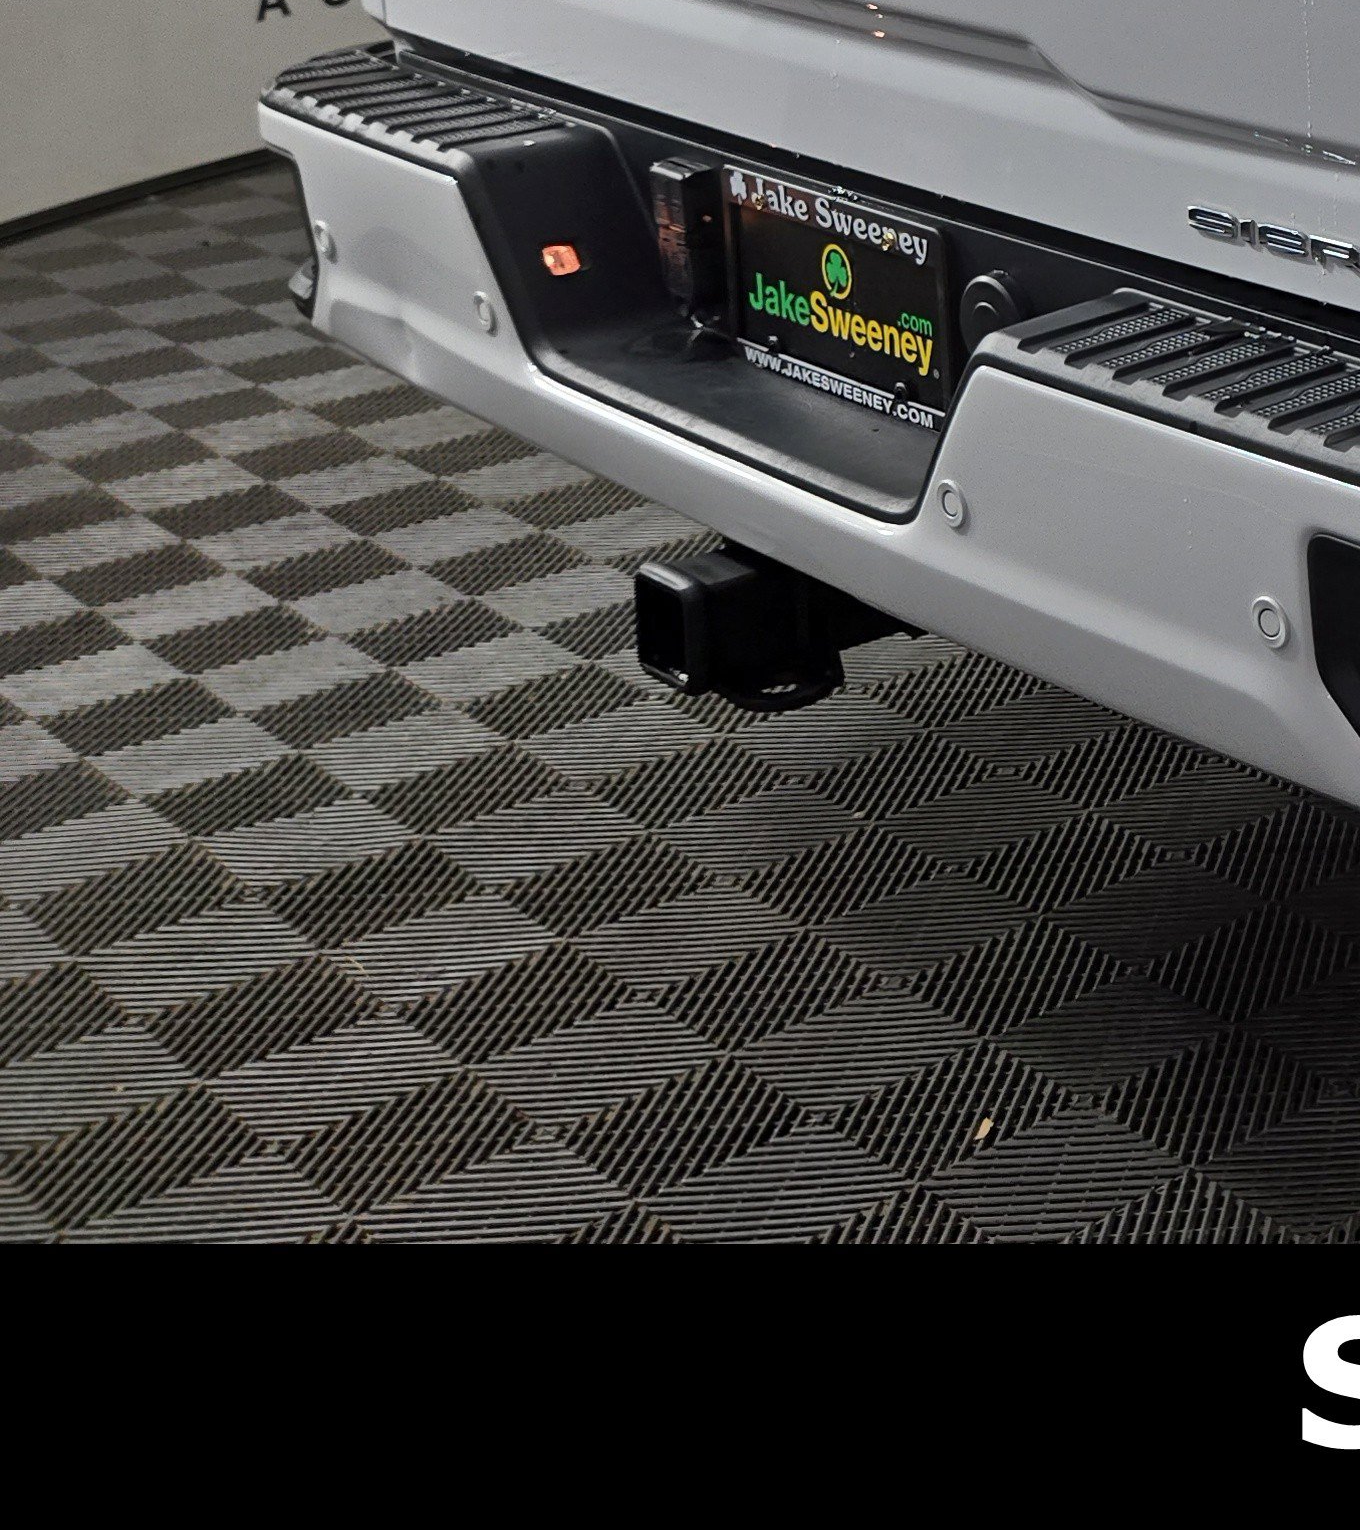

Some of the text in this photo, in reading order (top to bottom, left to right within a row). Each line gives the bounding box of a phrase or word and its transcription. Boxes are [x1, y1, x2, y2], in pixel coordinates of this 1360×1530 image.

[751, 177, 929, 266] Jake Sweeney
[744, 345, 935, 429] WWW.JAKESWEENEY.COM
